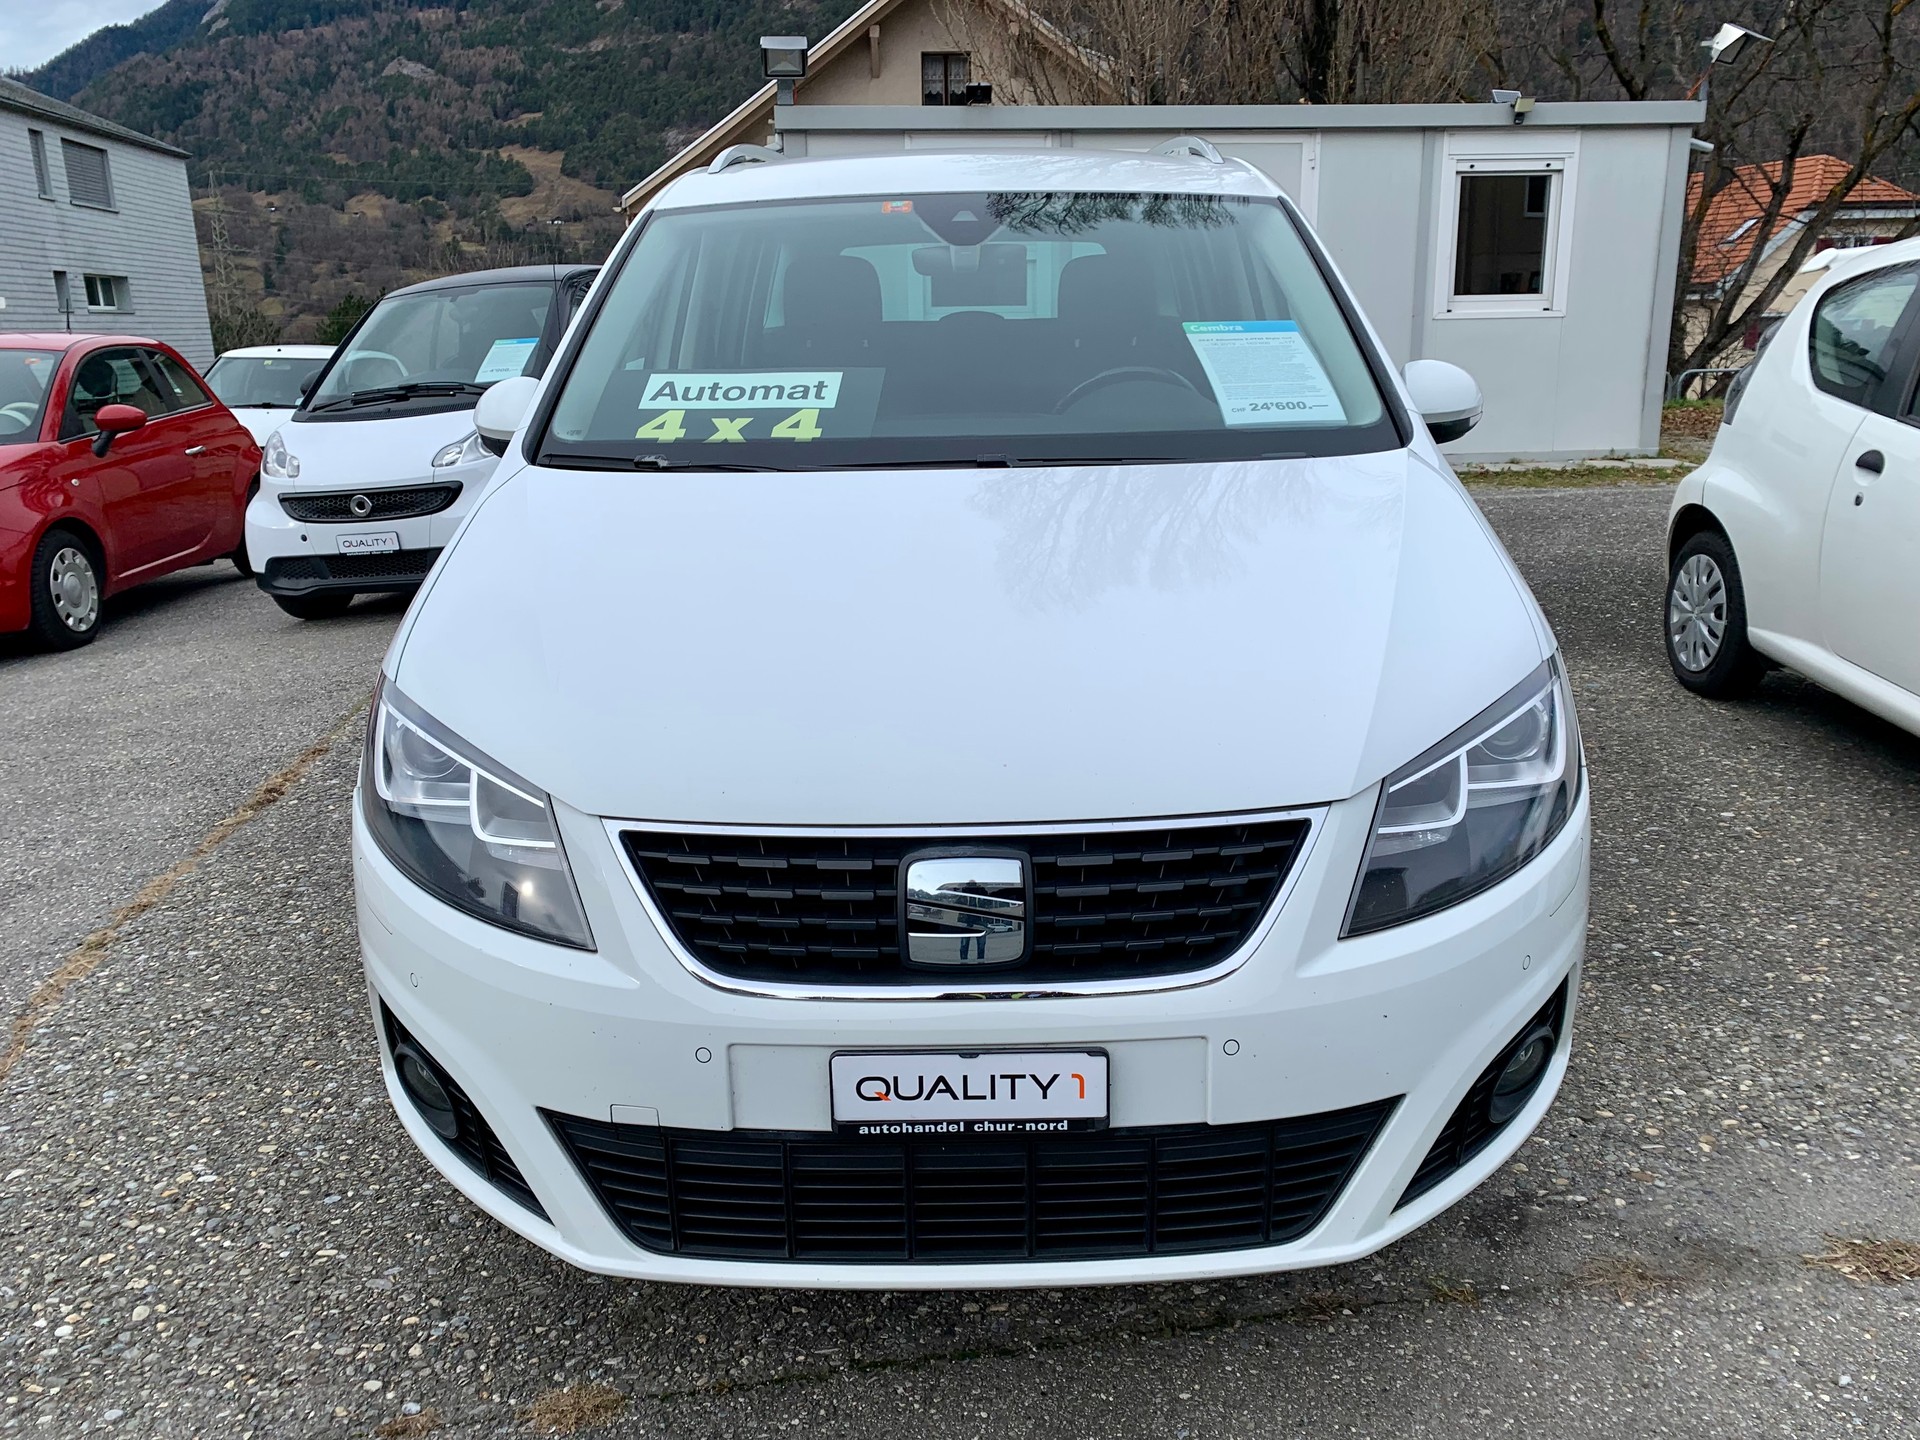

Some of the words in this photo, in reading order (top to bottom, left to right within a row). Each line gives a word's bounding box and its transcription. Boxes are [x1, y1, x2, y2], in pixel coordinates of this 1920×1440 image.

[1190, 324, 1244, 332] Cembra
[648, 381, 828, 402] Automat
[634, 409, 687, 443] 4
[702, 417, 754, 443] x
[770, 408, 823, 443] 4
[342, 538, 387, 548] QUALITY
[855, 1073, 1061, 1101] QUALITY
[1071, 1073, 1085, 1099] 1
[859, 1122, 965, 1135] autohandel
[974, 1120, 1068, 1132] chur-nord
